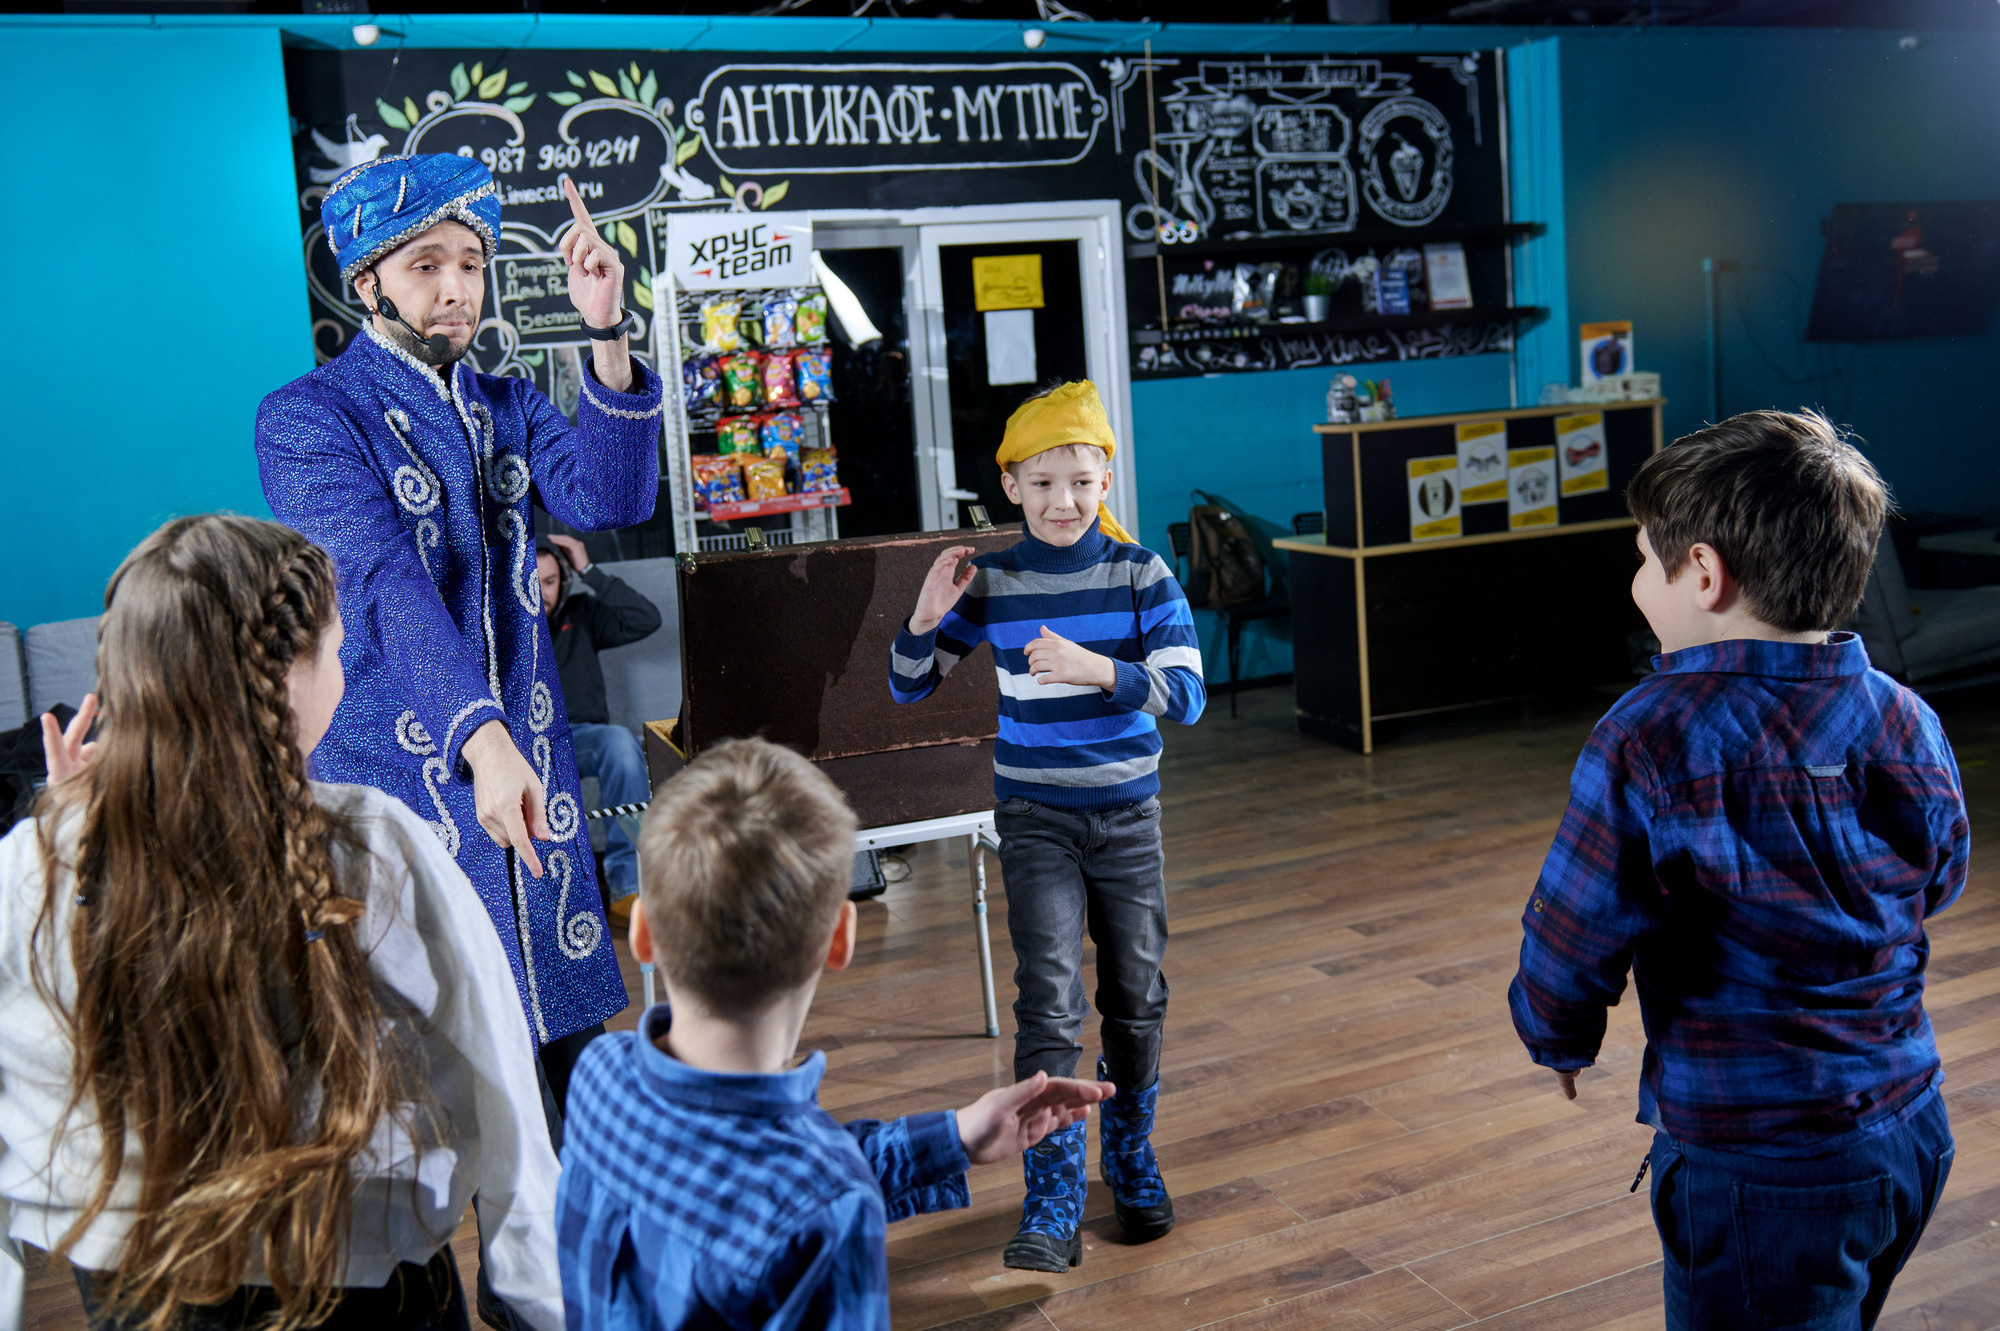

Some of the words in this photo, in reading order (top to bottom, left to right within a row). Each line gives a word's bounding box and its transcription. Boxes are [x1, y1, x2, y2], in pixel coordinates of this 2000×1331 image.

[715, 84, 941, 149] АНТИКАФЕ
[481, 145, 526, 174] 987
[537, 143, 582, 172] 960
[584, 134, 641, 169] 4241
[718, 244, 791, 279] team
[514, 305, 583, 331] Бесплат
